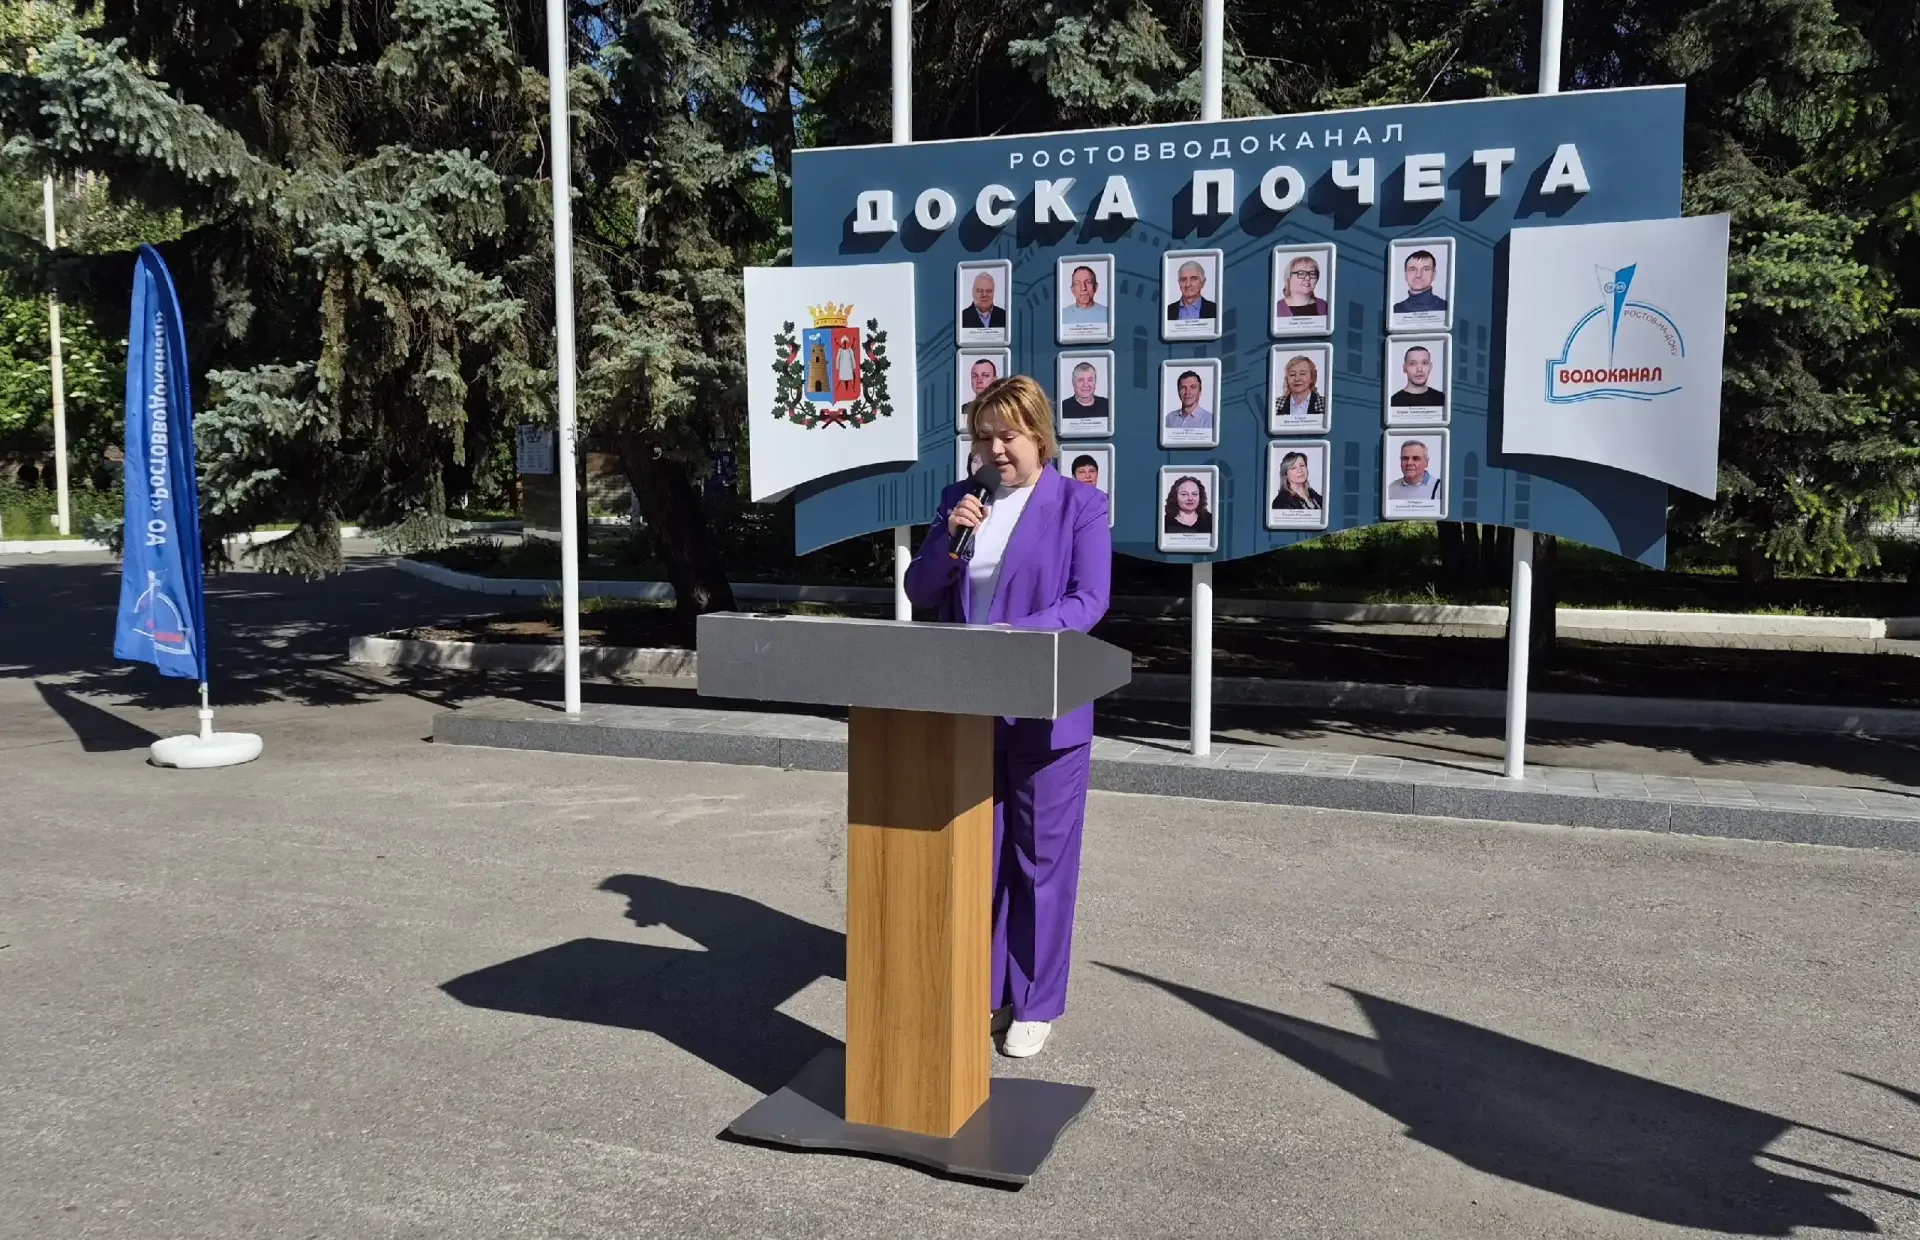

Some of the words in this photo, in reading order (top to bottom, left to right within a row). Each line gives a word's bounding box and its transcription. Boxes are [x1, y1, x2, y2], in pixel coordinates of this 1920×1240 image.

[1009, 123, 1404, 169] РОСТОВВОДОКАНАЛ
[853, 175, 1138, 233] ДОСКА
[1192, 143, 1591, 216] ПОЧЕТА
[1559, 368, 1662, 384] ВОДОКАНАЛ
